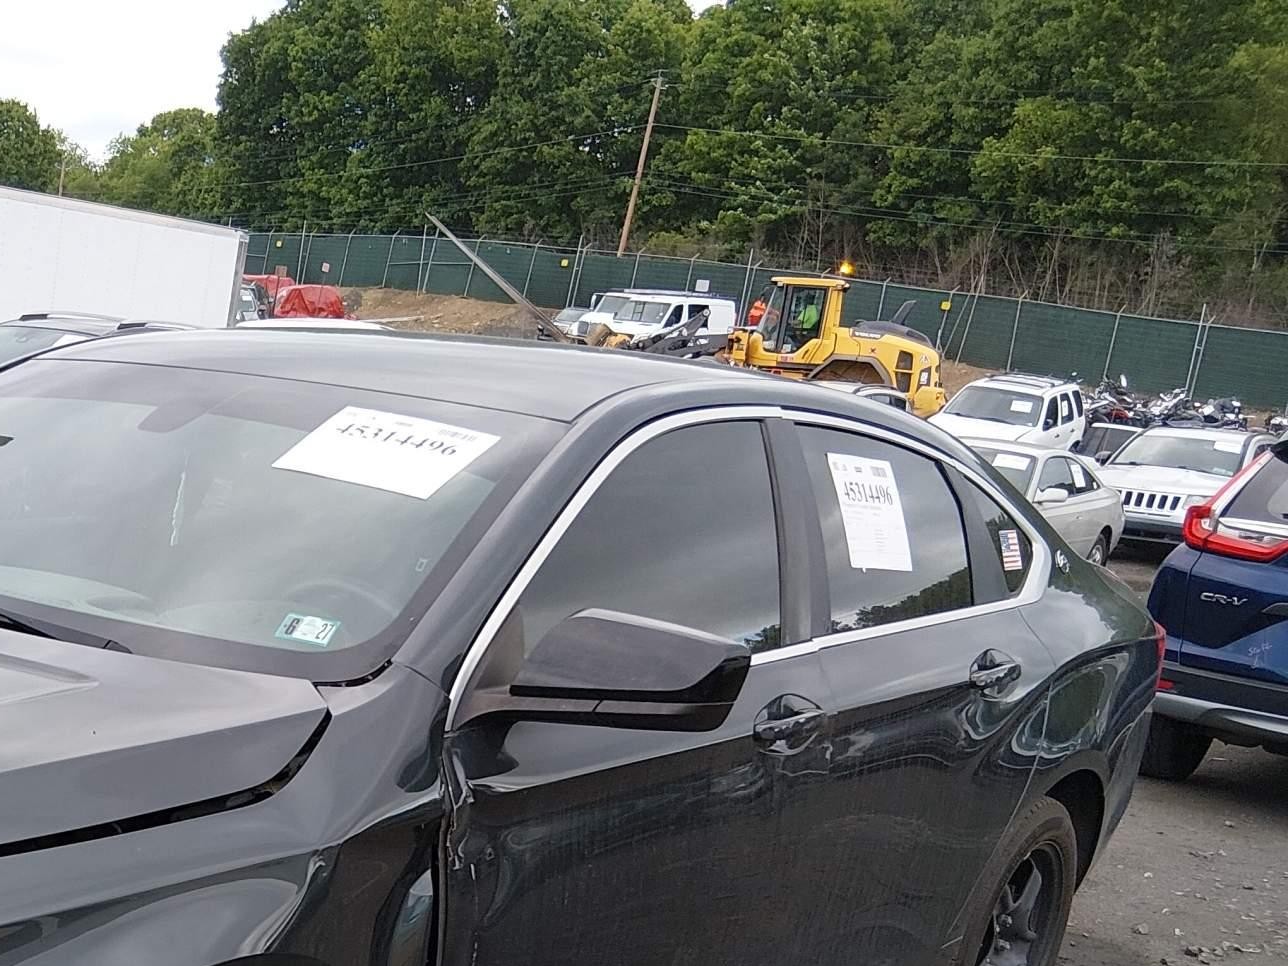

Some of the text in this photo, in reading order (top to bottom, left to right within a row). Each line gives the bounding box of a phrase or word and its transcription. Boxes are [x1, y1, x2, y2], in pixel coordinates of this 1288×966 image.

[336, 423, 457, 456] 45314496
[844, 481, 894, 506] 45314496
[1200, 592, 1248, 605] CR-V
[314, 623, 335, 640] 27
